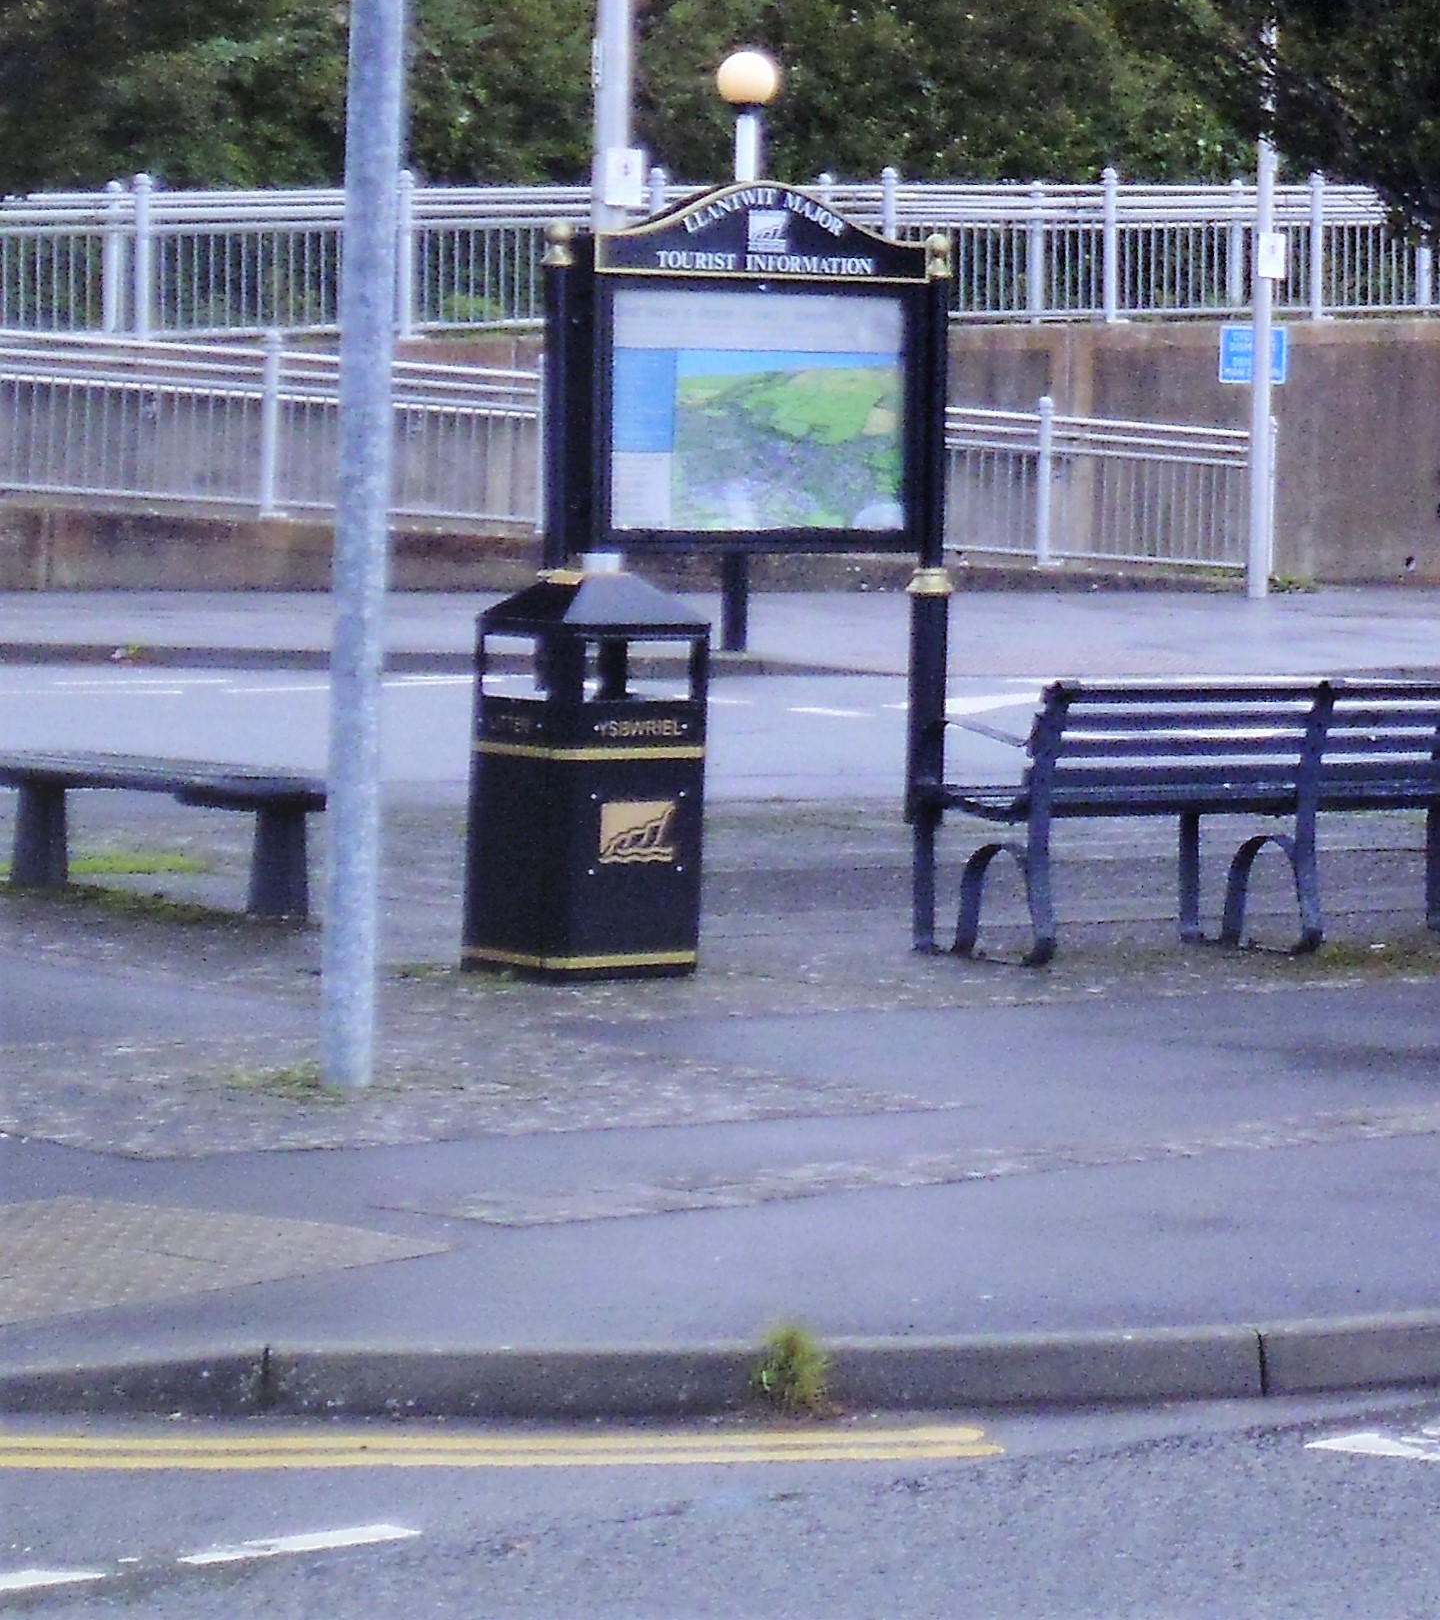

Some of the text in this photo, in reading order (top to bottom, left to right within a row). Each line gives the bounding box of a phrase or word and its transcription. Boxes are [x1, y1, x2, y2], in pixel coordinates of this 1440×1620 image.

[682, 188, 844, 236] LLANTWIT MAJOR
[656, 250, 873, 275] TOURIST INFORMATION
[599, 718, 683, 737] YSBWRIEL
